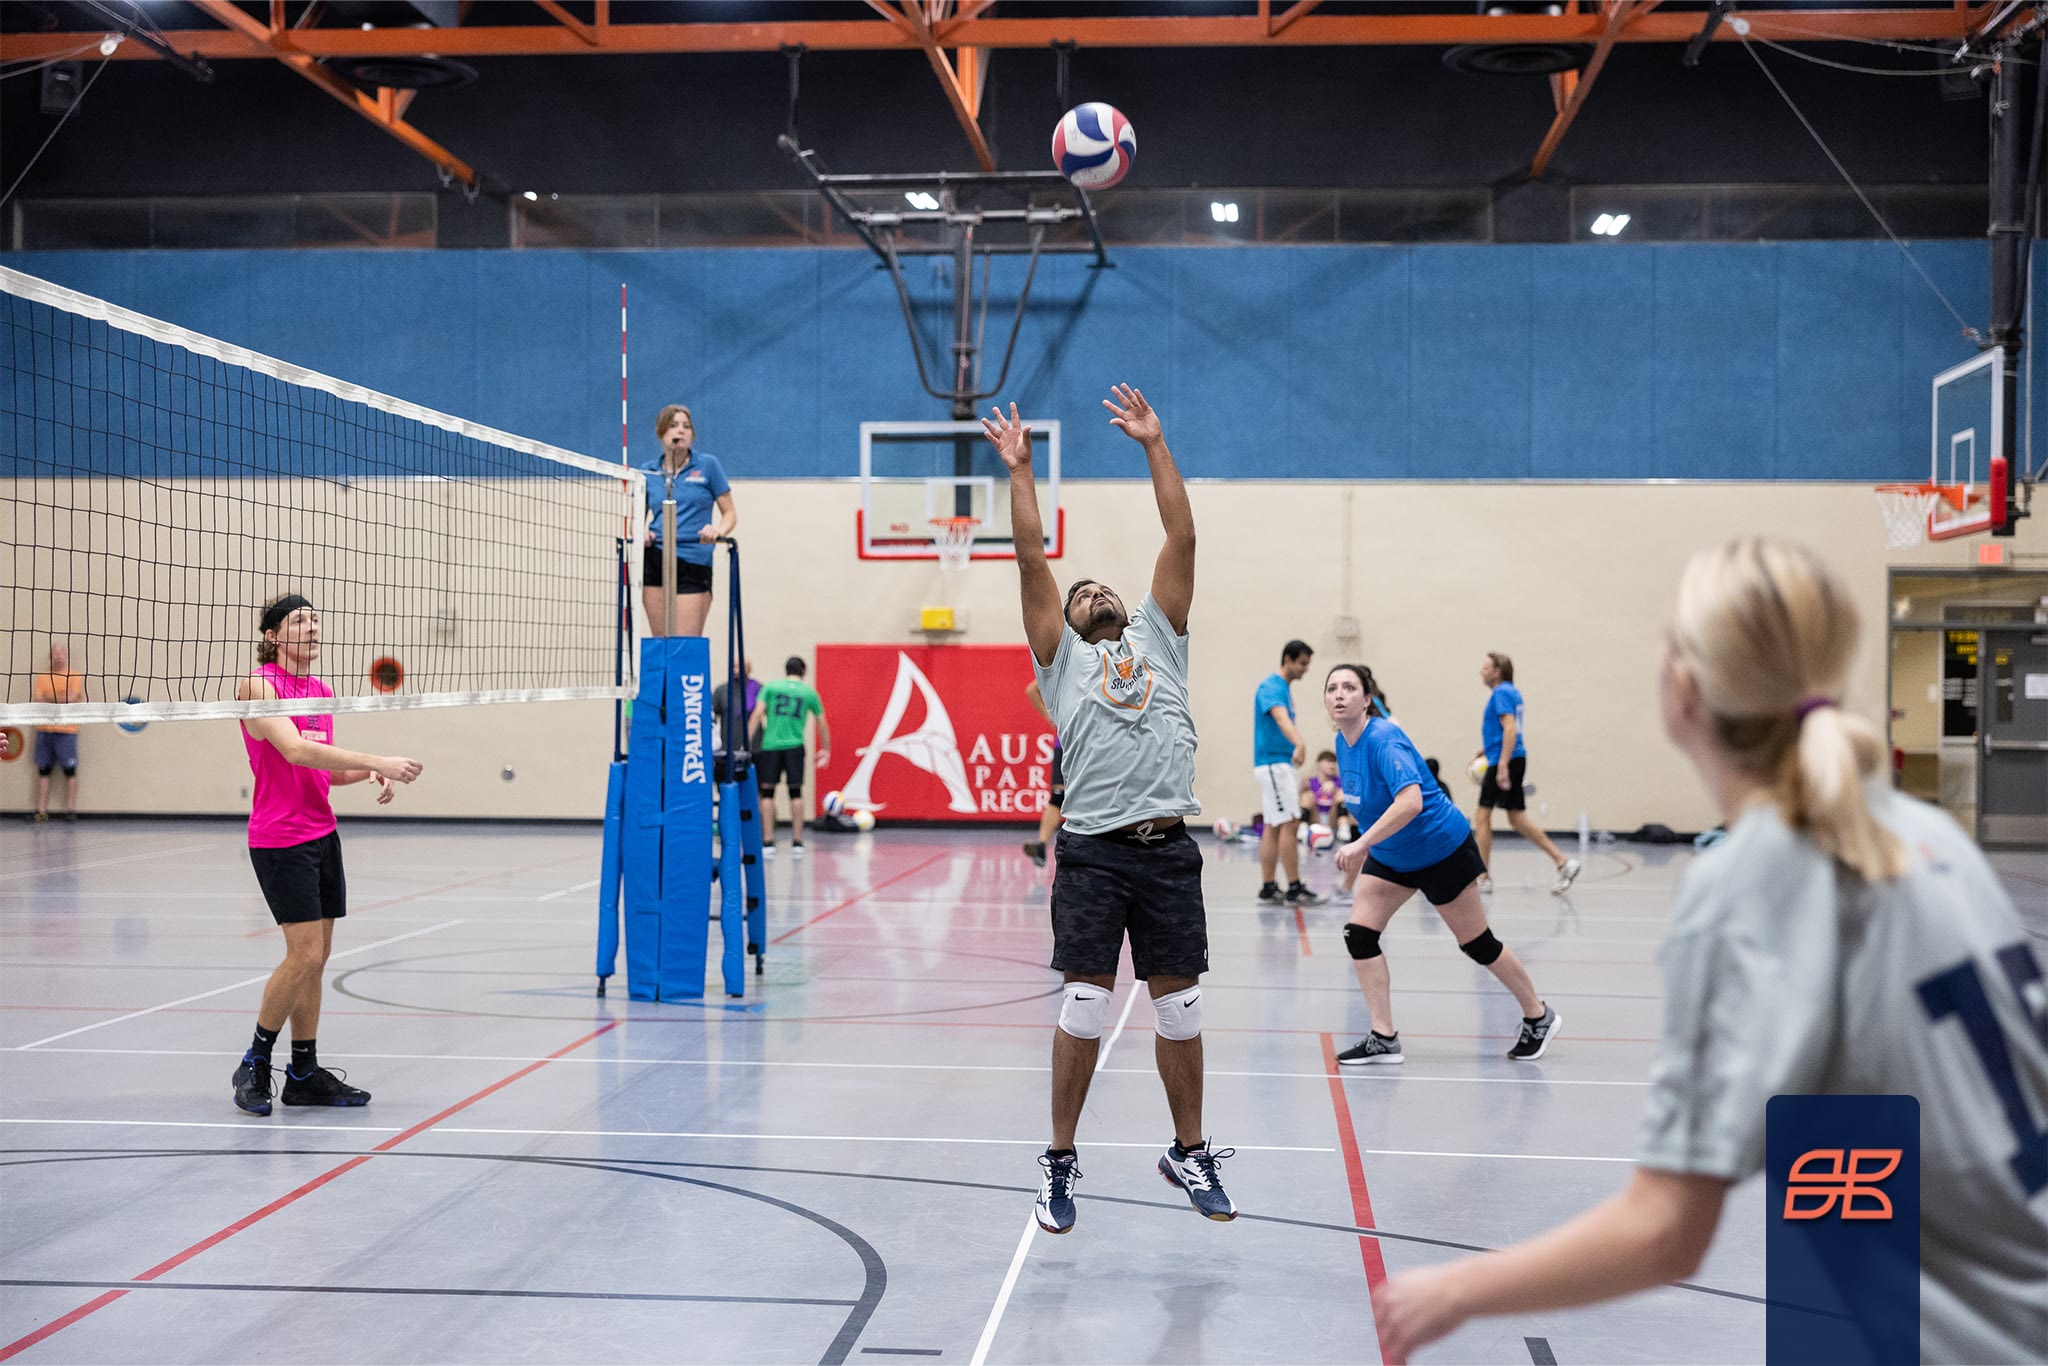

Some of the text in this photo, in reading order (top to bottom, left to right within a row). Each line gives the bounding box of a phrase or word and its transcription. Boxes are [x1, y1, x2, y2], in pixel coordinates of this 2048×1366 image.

[774, 692, 804, 719] 21
[681, 673, 706, 784] SPALDING
[968, 732, 1055, 765] AUS
[975, 765, 1049, 789] PAR
